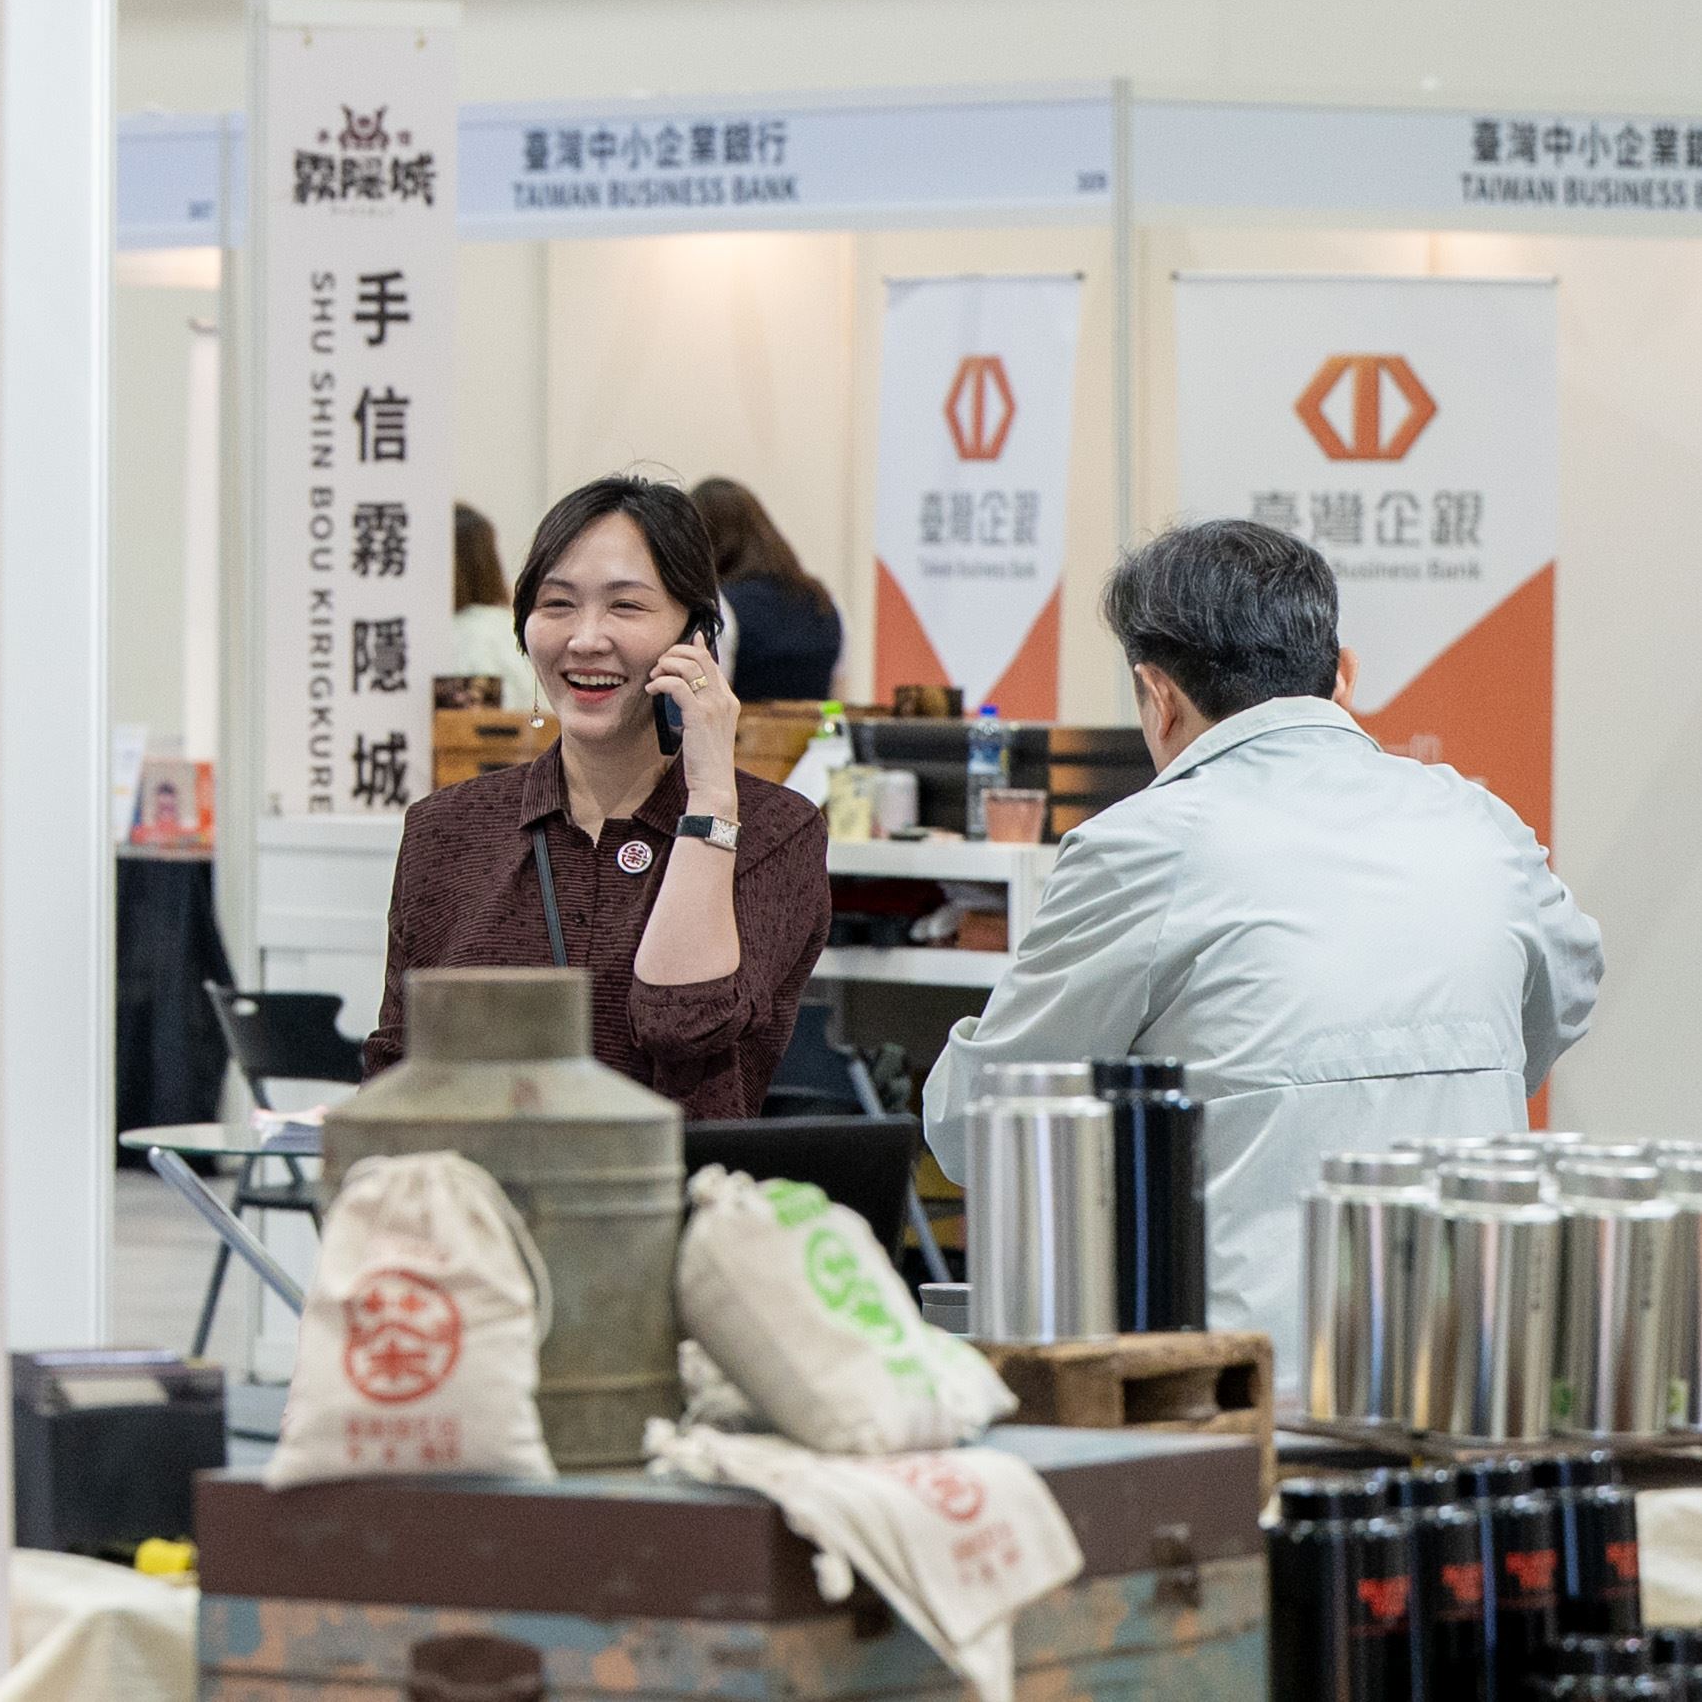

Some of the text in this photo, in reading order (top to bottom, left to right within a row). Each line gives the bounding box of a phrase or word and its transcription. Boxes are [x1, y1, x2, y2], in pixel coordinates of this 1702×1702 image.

[522, 117, 788, 174] 臺灣中小企業銀行
[512, 175, 798, 209] TAIWAN BUSINESS BANK
[1461, 172, 1557, 203] TAIWAN
[1563, 176, 1689, 209] BUSINESS
[310, 271, 337, 355] SHU
[310, 371, 336, 469] SHIN
[309, 485, 335, 572] BOU
[352, 270, 411, 808] 手信霧隱城
